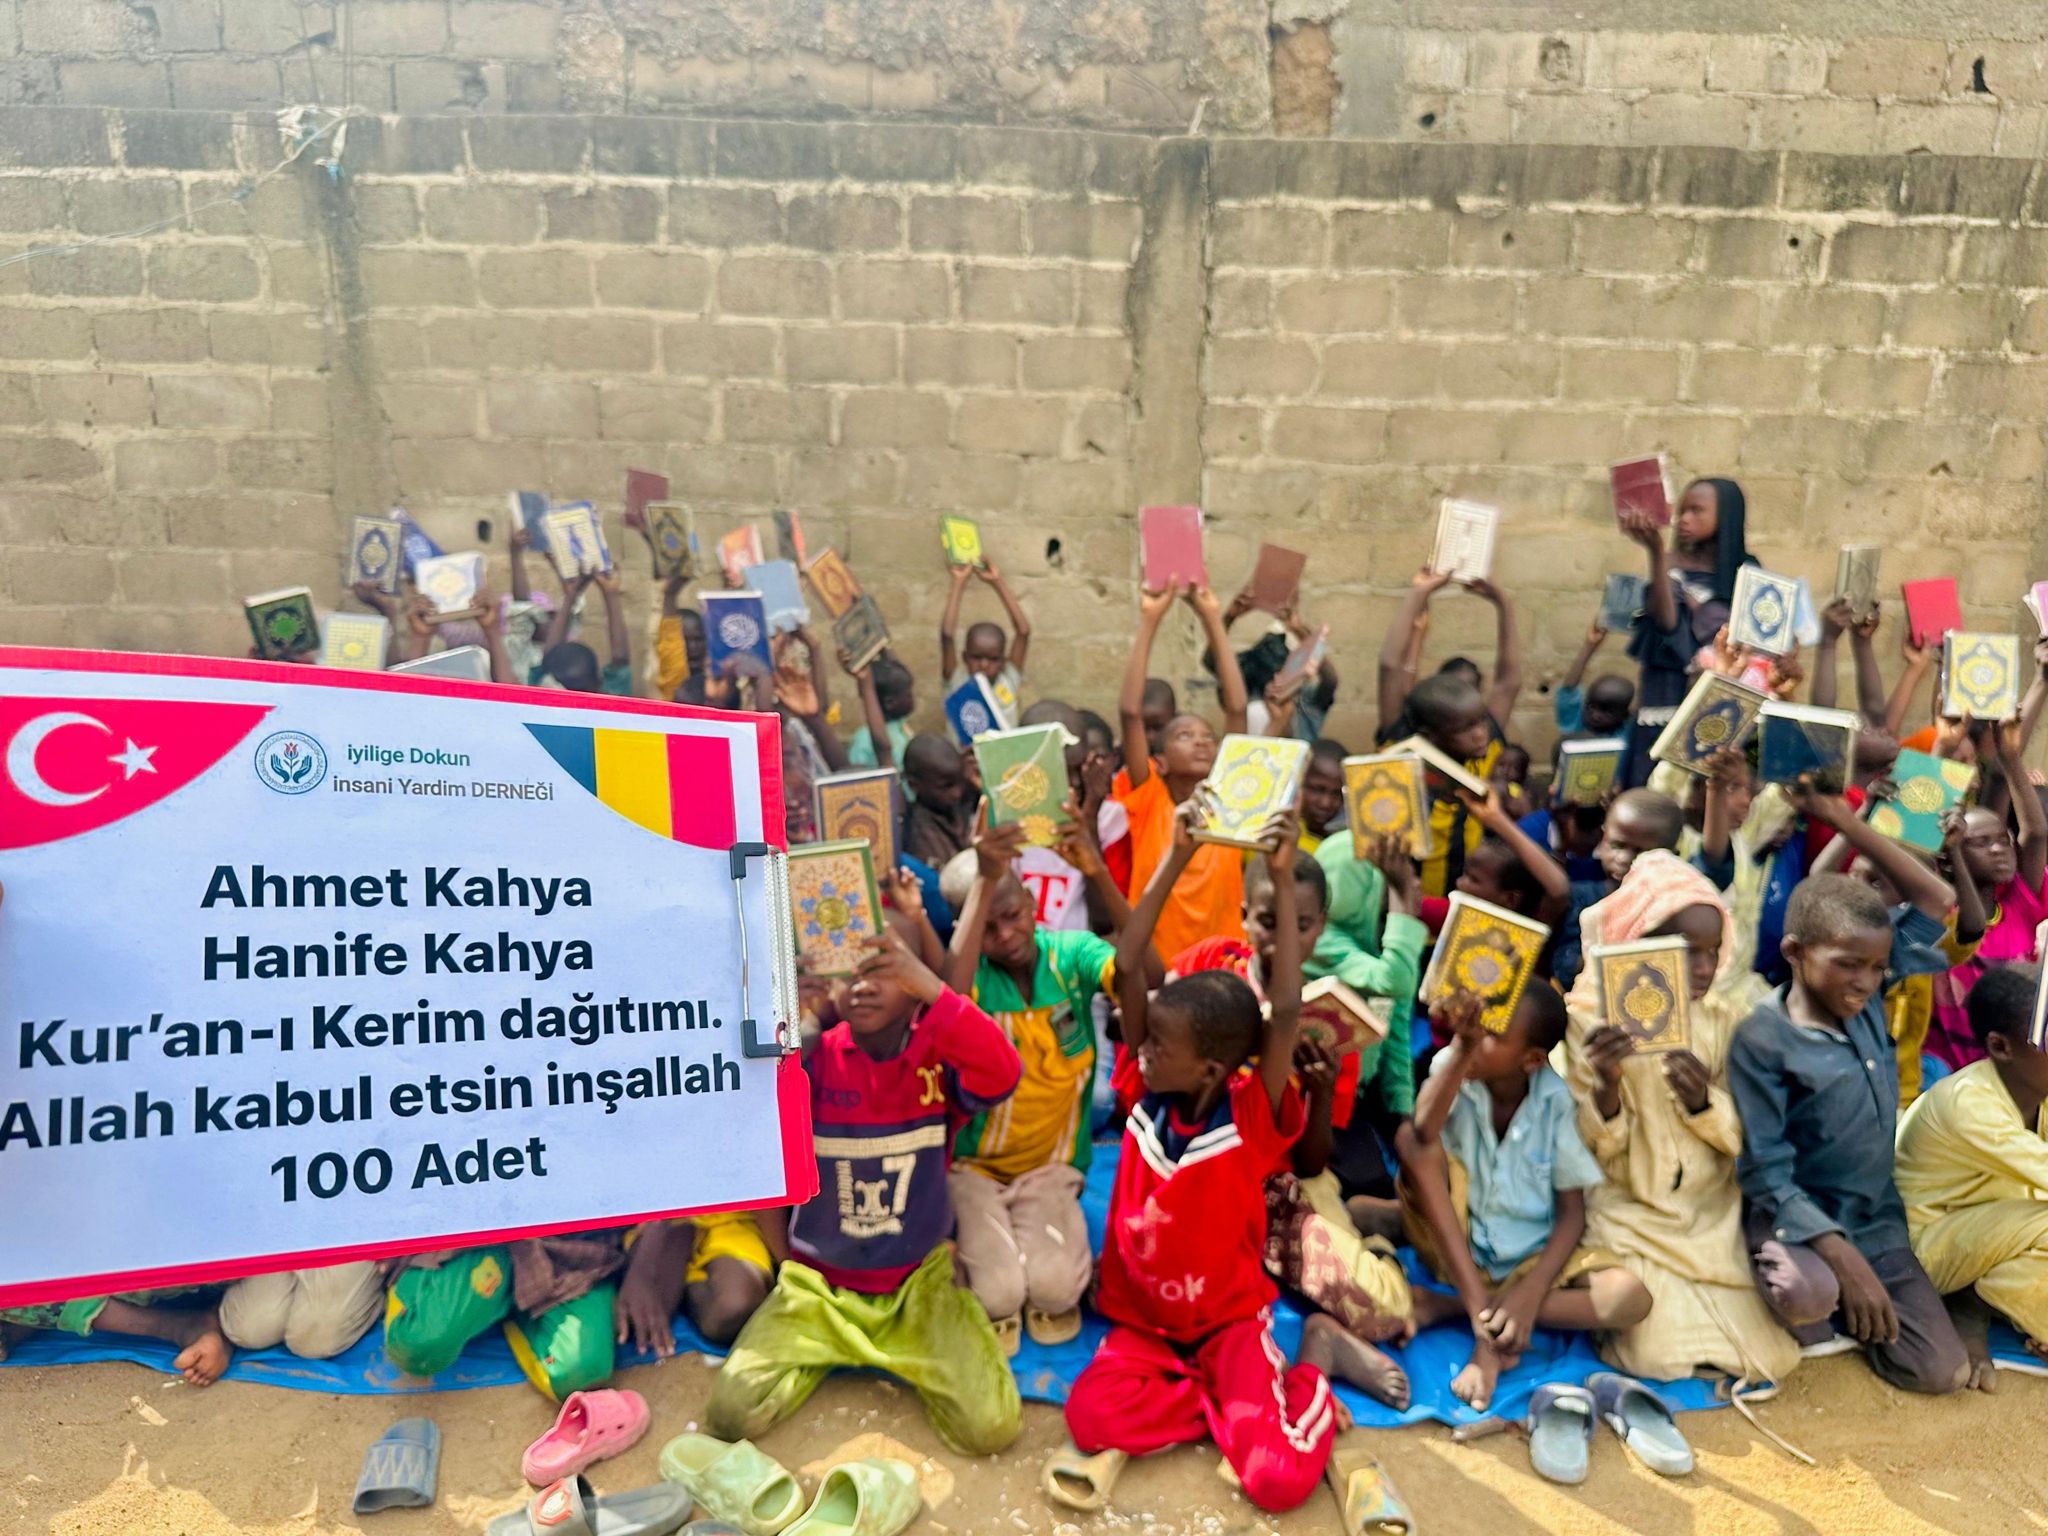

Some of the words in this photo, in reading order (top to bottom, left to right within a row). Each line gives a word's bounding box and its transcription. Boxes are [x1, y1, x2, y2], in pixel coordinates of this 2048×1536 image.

[347, 743, 405, 766] iyilige
[410, 747, 470, 767] Dokun
[398, 778, 466, 797] Yardim
[471, 781, 554, 801] DERNEĞİ
[201, 866, 408, 908] Ahmet
[425, 866, 592, 916] Kahya
[205, 931, 408, 981] Hanife
[424, 931, 593, 981] Kahya
[312, 997, 485, 1050] Kerim
[500, 991, 722, 1046] dağıtımı.
[0, 1091, 174, 1152] Allah
[194, 1075, 372, 1134] kabul
[389, 1064, 533, 1118] etsin
[547, 1052, 741, 1115] inşallah
[271, 1148, 393, 1203] 100
[411, 1137, 548, 1190] Adet
